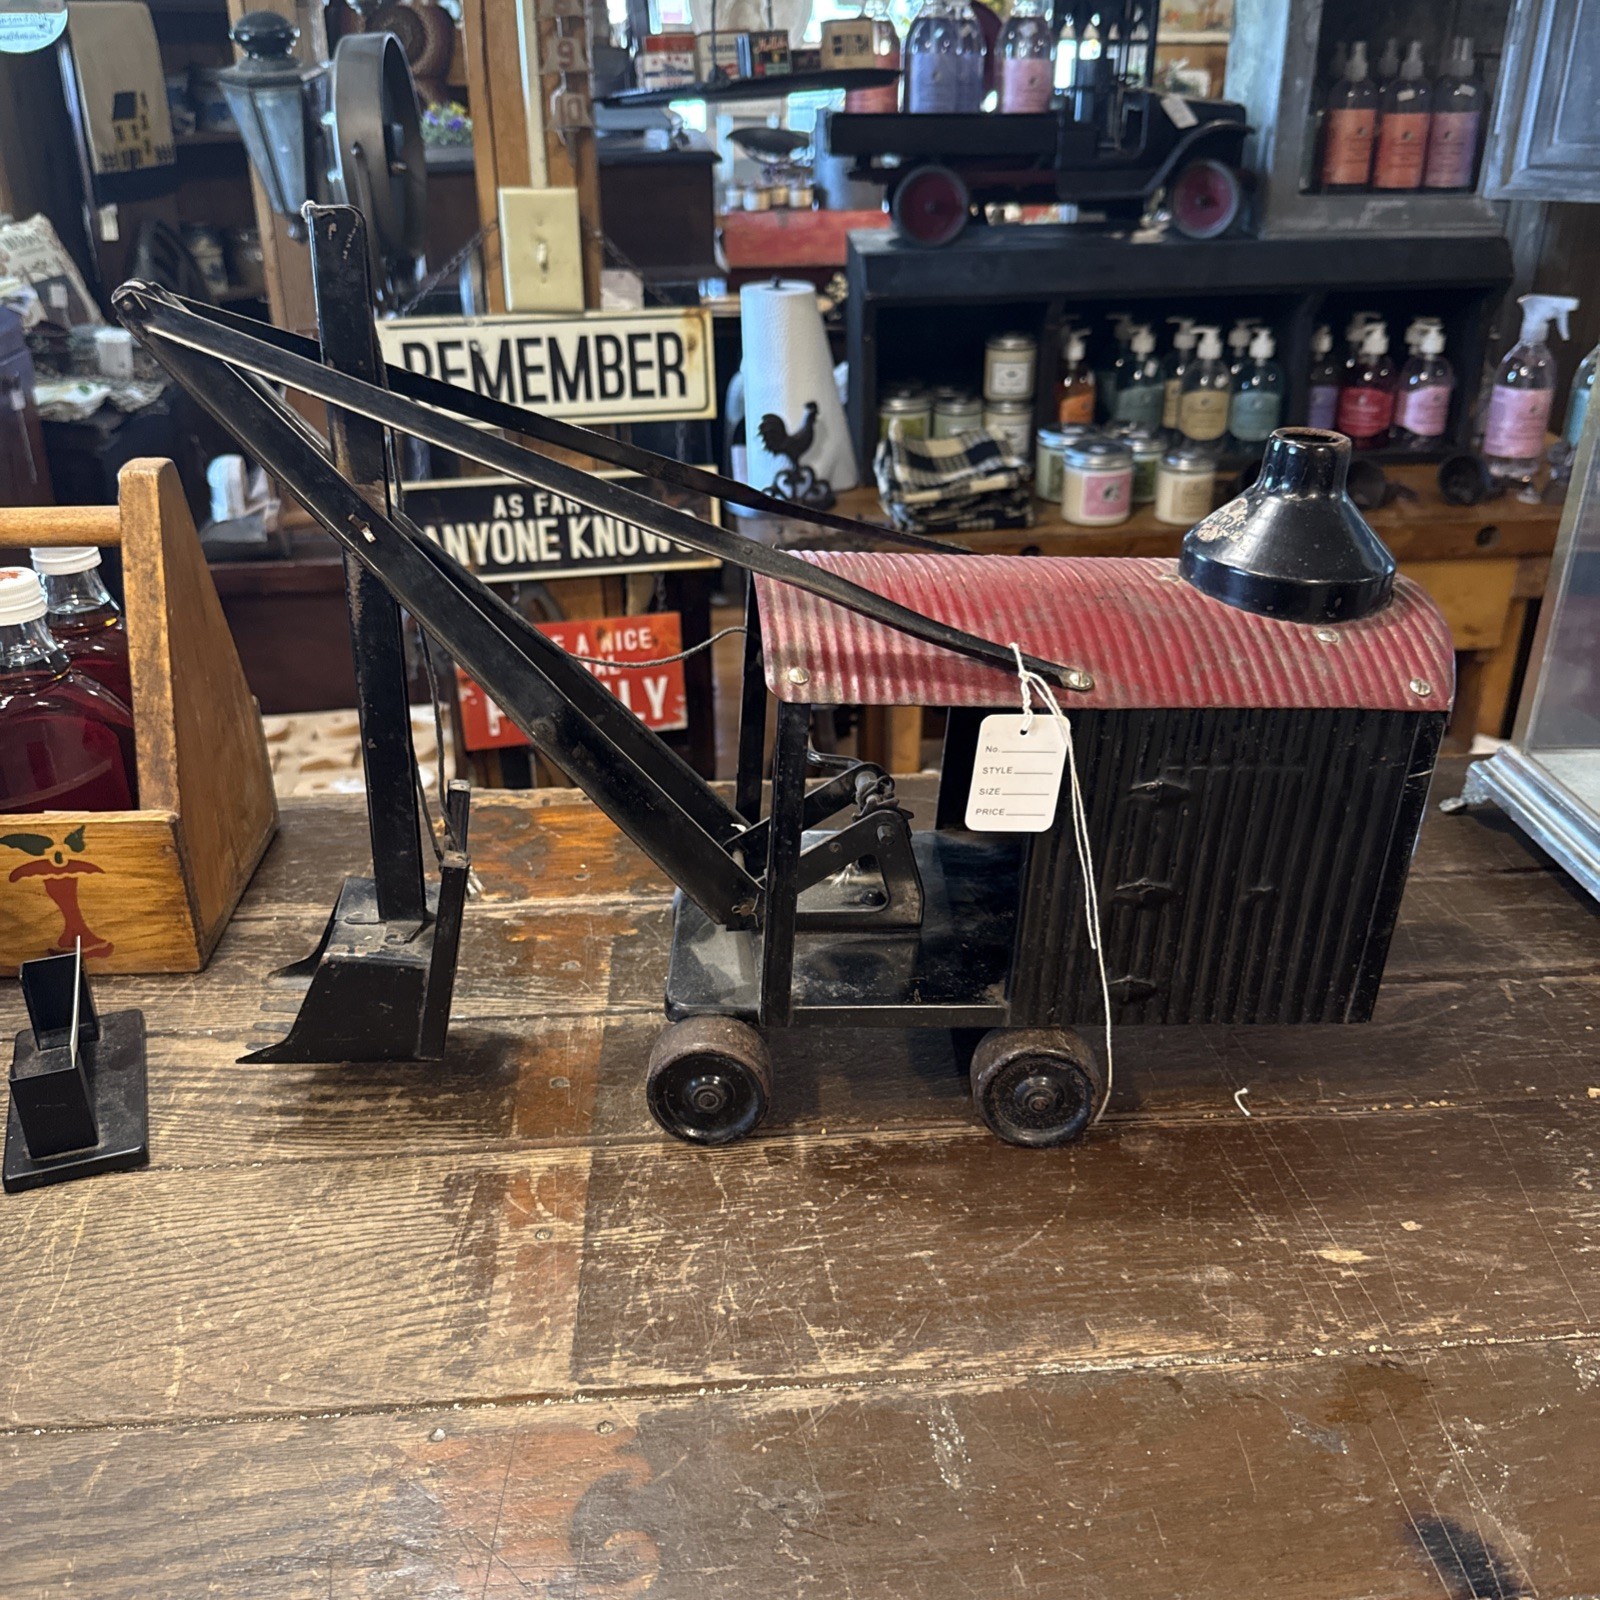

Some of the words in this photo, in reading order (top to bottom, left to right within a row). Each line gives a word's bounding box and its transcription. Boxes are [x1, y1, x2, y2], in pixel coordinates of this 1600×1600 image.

[493, 492, 525, 519] AS
[576, 632, 590, 655] A
[599, 627, 653, 653] NICE
[982, 766, 1013, 775] STYLE
[978, 787, 1001, 796] SIZE
[975, 808, 1005, 817] PRICE
